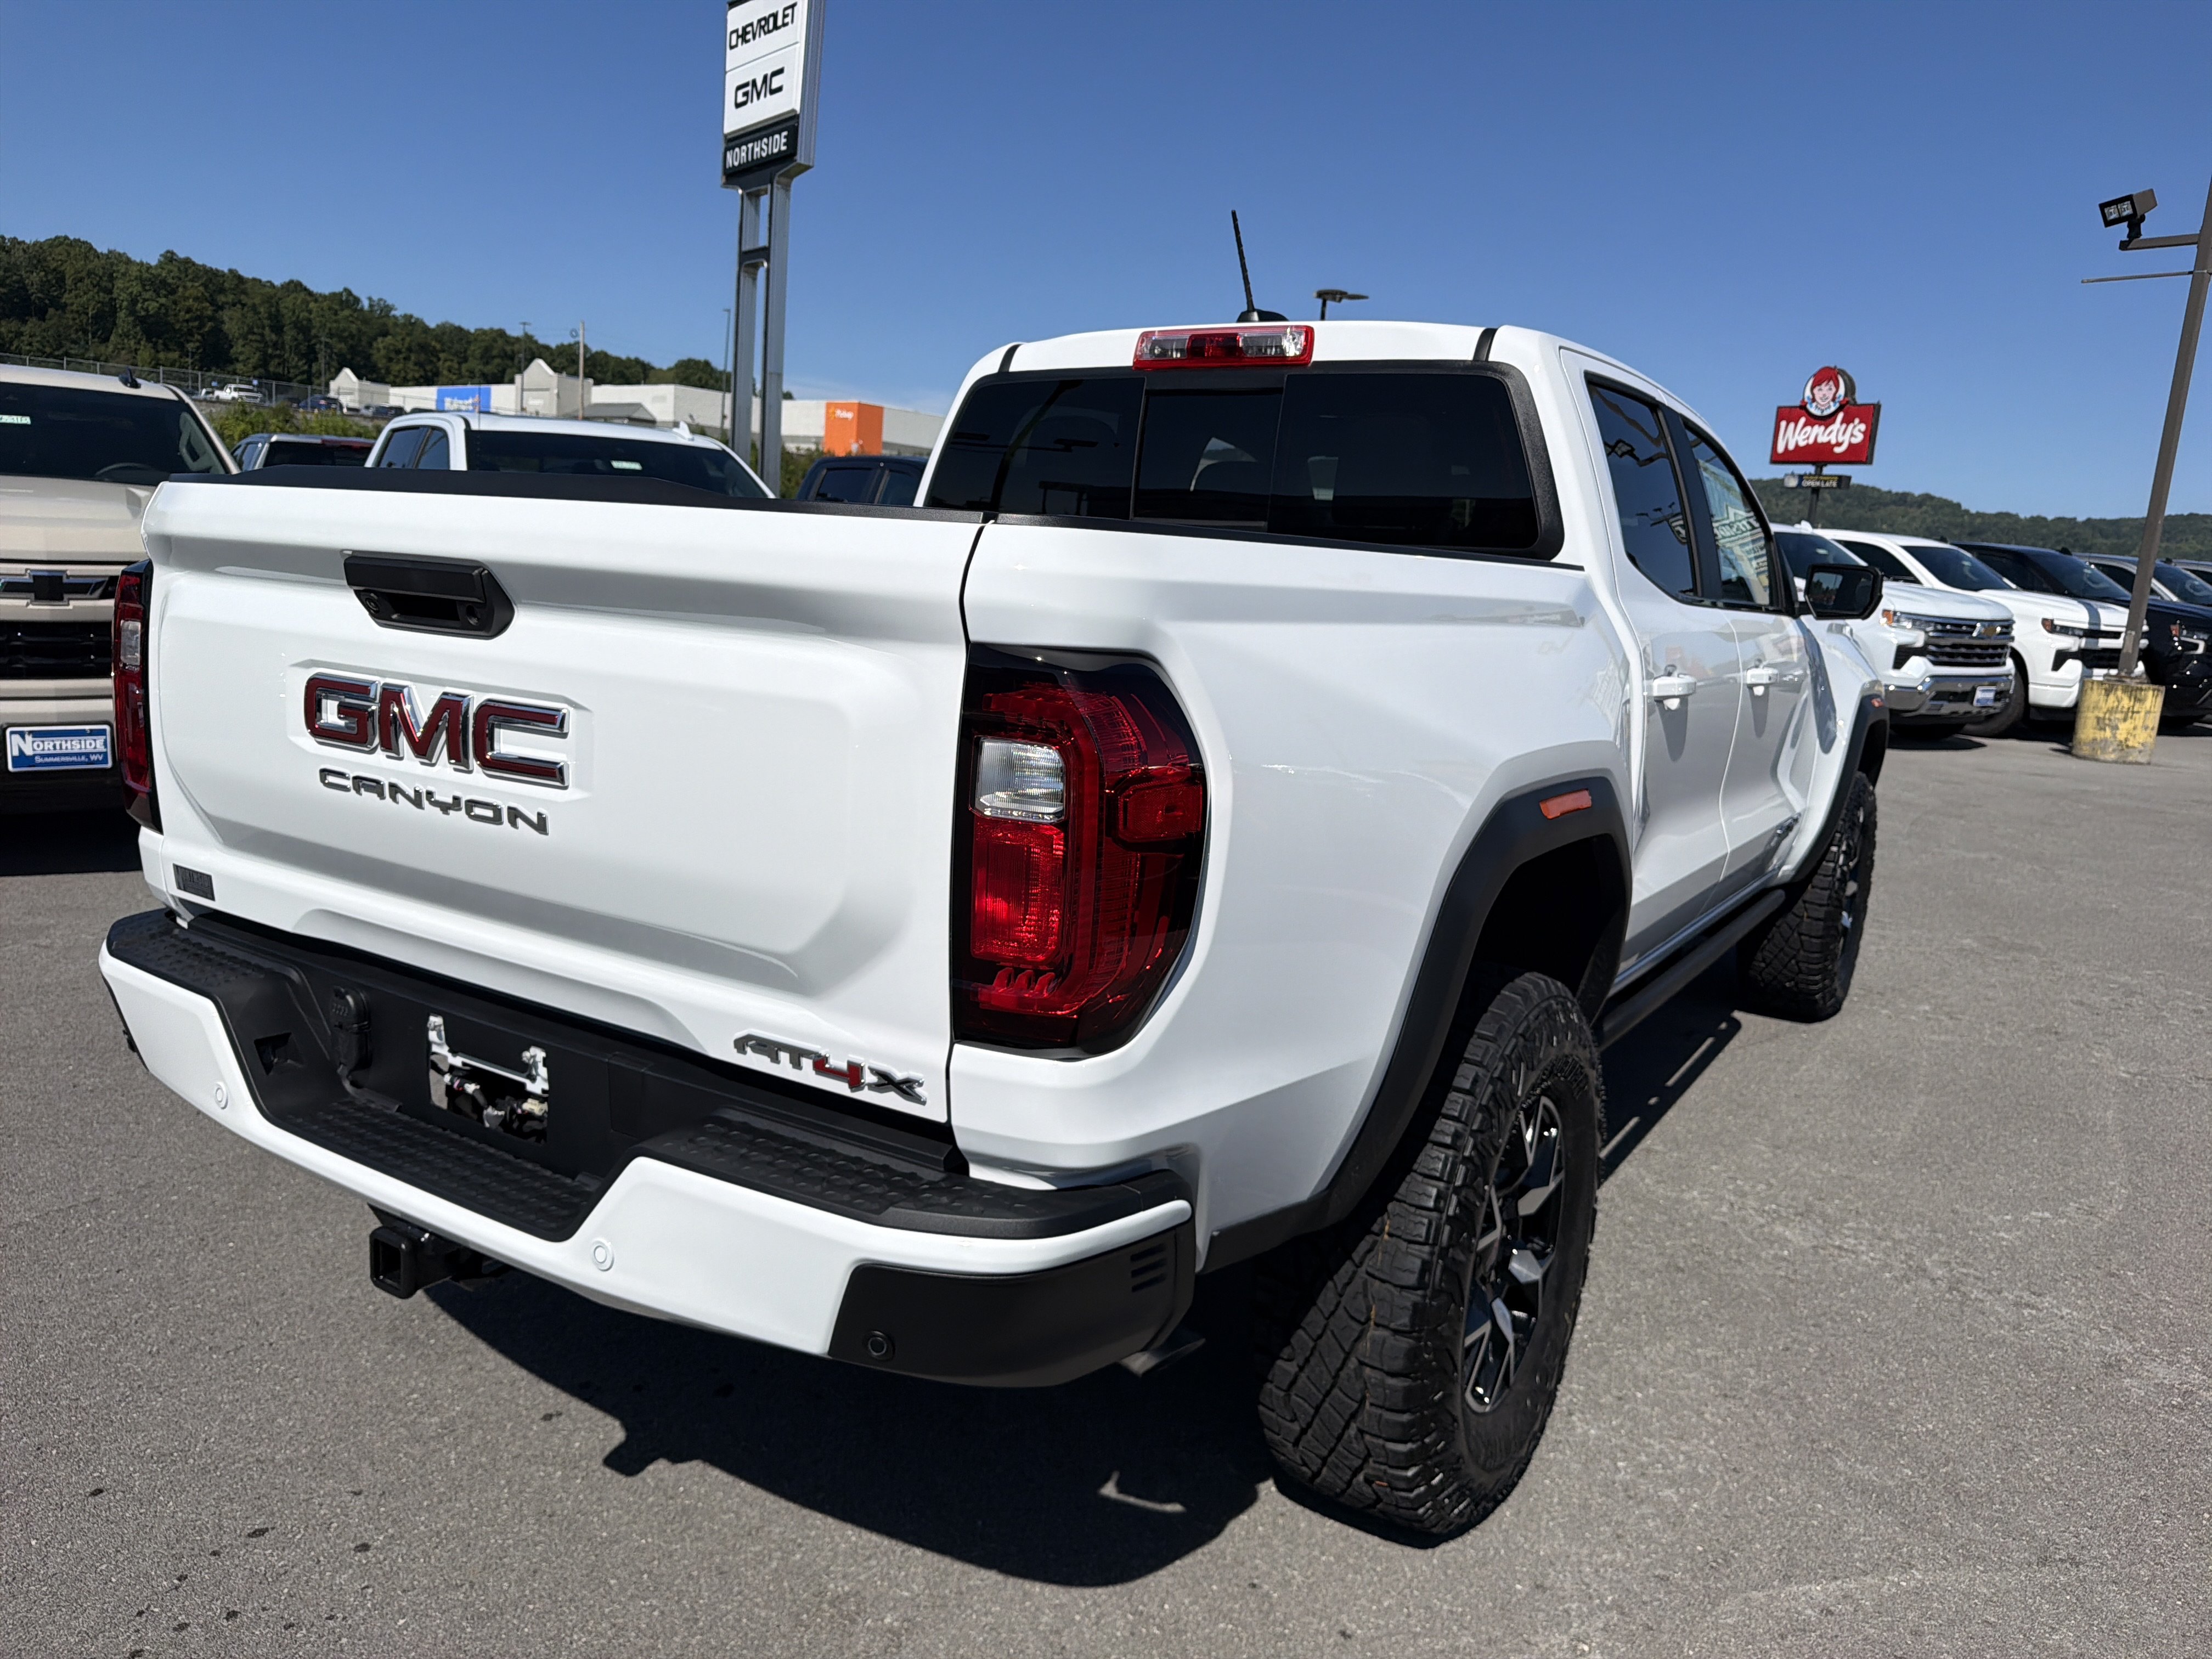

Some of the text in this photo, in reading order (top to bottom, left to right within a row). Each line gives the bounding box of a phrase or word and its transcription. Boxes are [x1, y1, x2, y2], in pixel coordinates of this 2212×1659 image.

[729, 3, 797, 50] CHEVROLET
[734, 66, 785, 109] GMC
[726, 131, 788, 169] NORTHSIDE
[1776, 411, 1866, 454] Wendy's
[10, 733, 106, 757] NORTHSIDE
[304, 670, 571, 790] GMC
[319, 767, 549, 836] CANYON
[733, 1031, 928, 1107] AT4X
